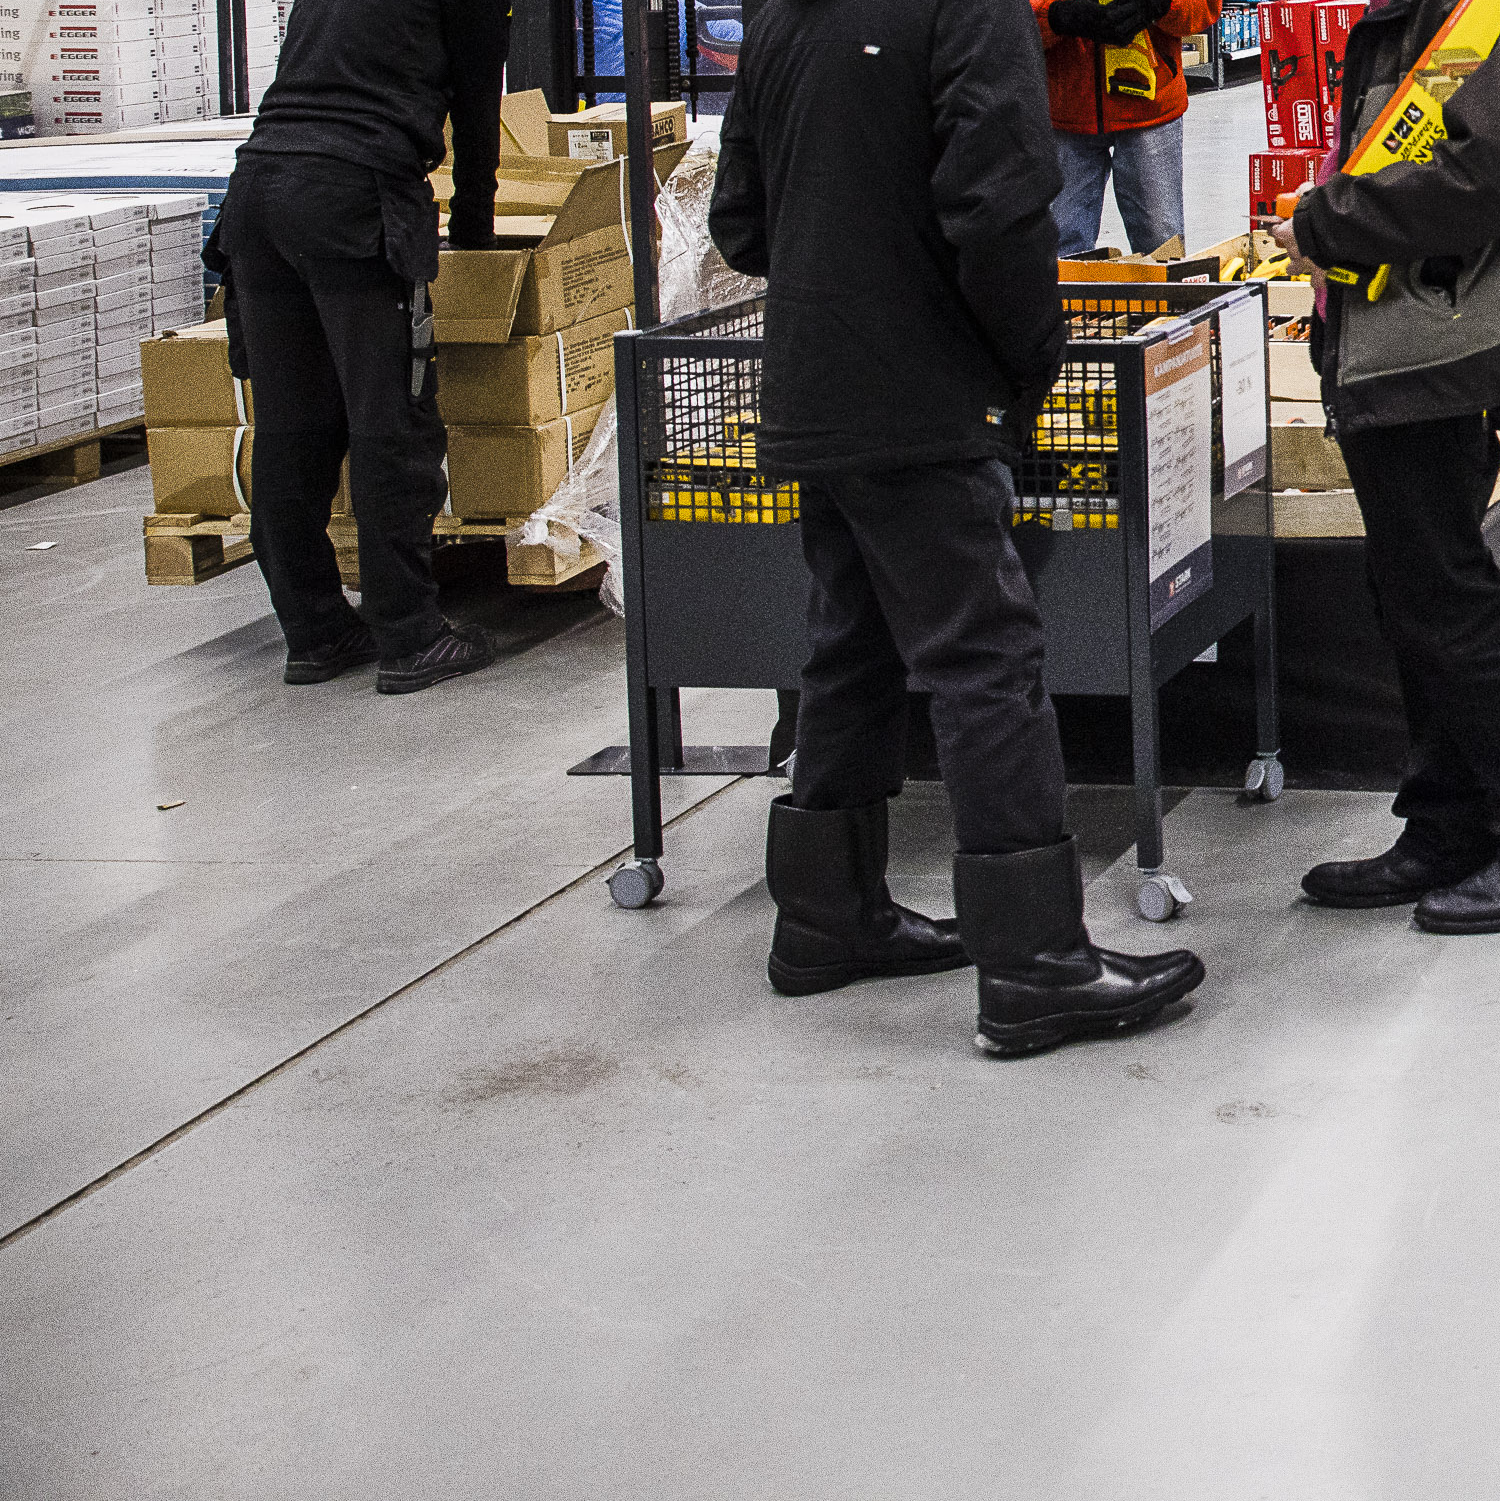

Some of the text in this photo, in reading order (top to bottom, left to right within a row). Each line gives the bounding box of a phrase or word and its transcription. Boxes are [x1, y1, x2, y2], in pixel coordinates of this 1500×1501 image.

[58, 9, 97, 17] EGGER
[59, 31, 98, 39] EGGER
[1297, 103, 1314, 142] SENCO
